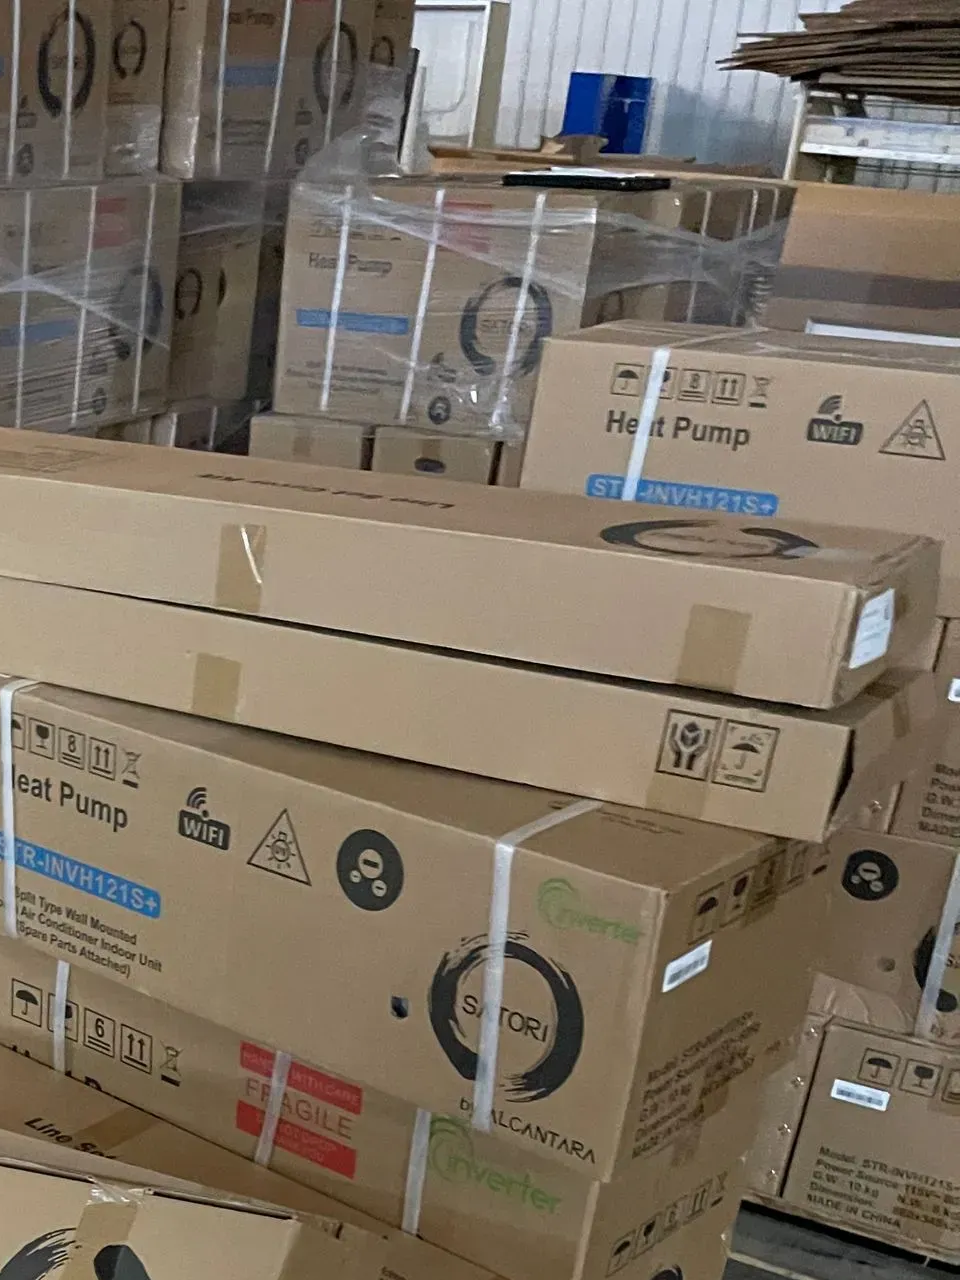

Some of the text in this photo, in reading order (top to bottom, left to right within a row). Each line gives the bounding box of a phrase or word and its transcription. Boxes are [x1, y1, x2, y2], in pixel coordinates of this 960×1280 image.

[672, 416, 750, 451] Pump
[812, 424, 856, 443] WIFI
[594, 479, 774, 513] ST-INVH121S+
[60, 780, 128, 832] Pump
[183, 816, 225, 847] WIFI
[39, 896, 63, 915] Type
[65, 907, 88, 925] Wall
[90, 917, 137, 945] Mounted
[38, 913, 98, 946] Conditioner
[101, 938, 136, 962] Indoor
[139, 953, 162, 972] Unit
[50, 934, 77, 954] Parts
[79, 946, 131, 979] Attached)
[95, 1018, 105, 1038] 6
[462, 994, 548, 1043] STORI
[24, 1117, 73, 1144] Line
